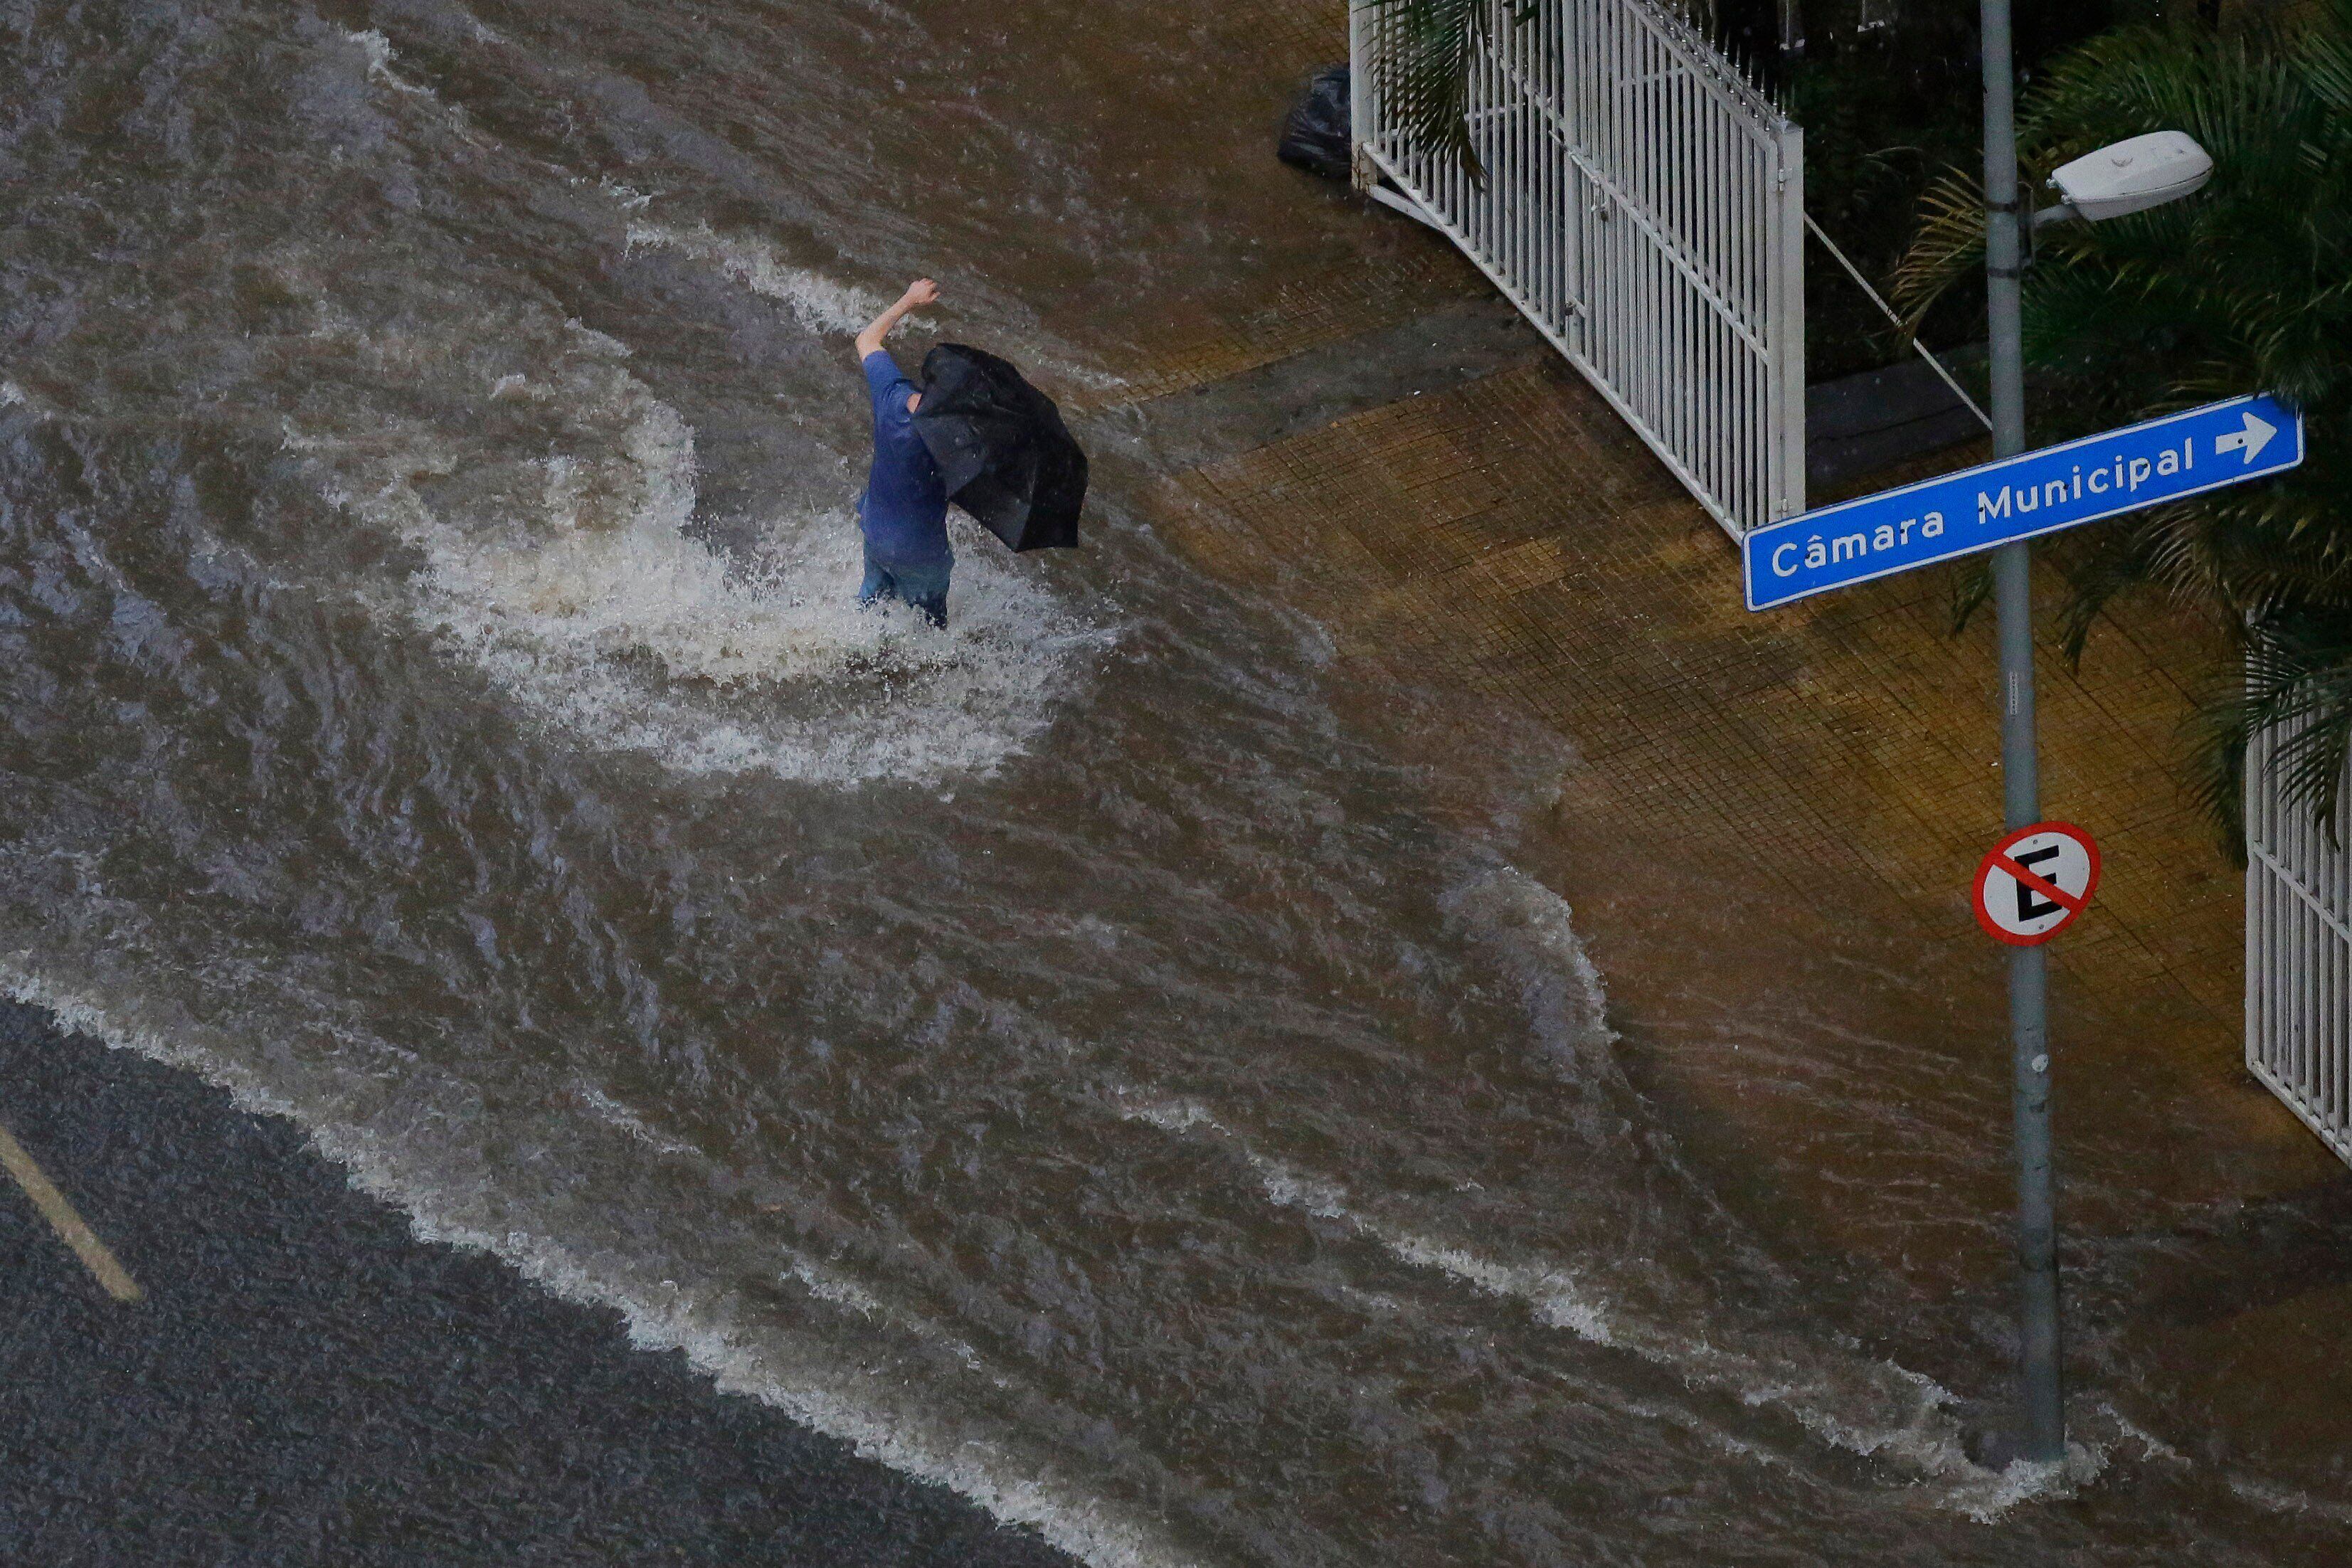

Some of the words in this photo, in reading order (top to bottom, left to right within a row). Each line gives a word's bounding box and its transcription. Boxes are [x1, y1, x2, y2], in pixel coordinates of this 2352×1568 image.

[1771, 509, 1944, 577] Câmara
[1978, 438, 2193, 524] Municipal
[2014, 845, 2063, 922] E
